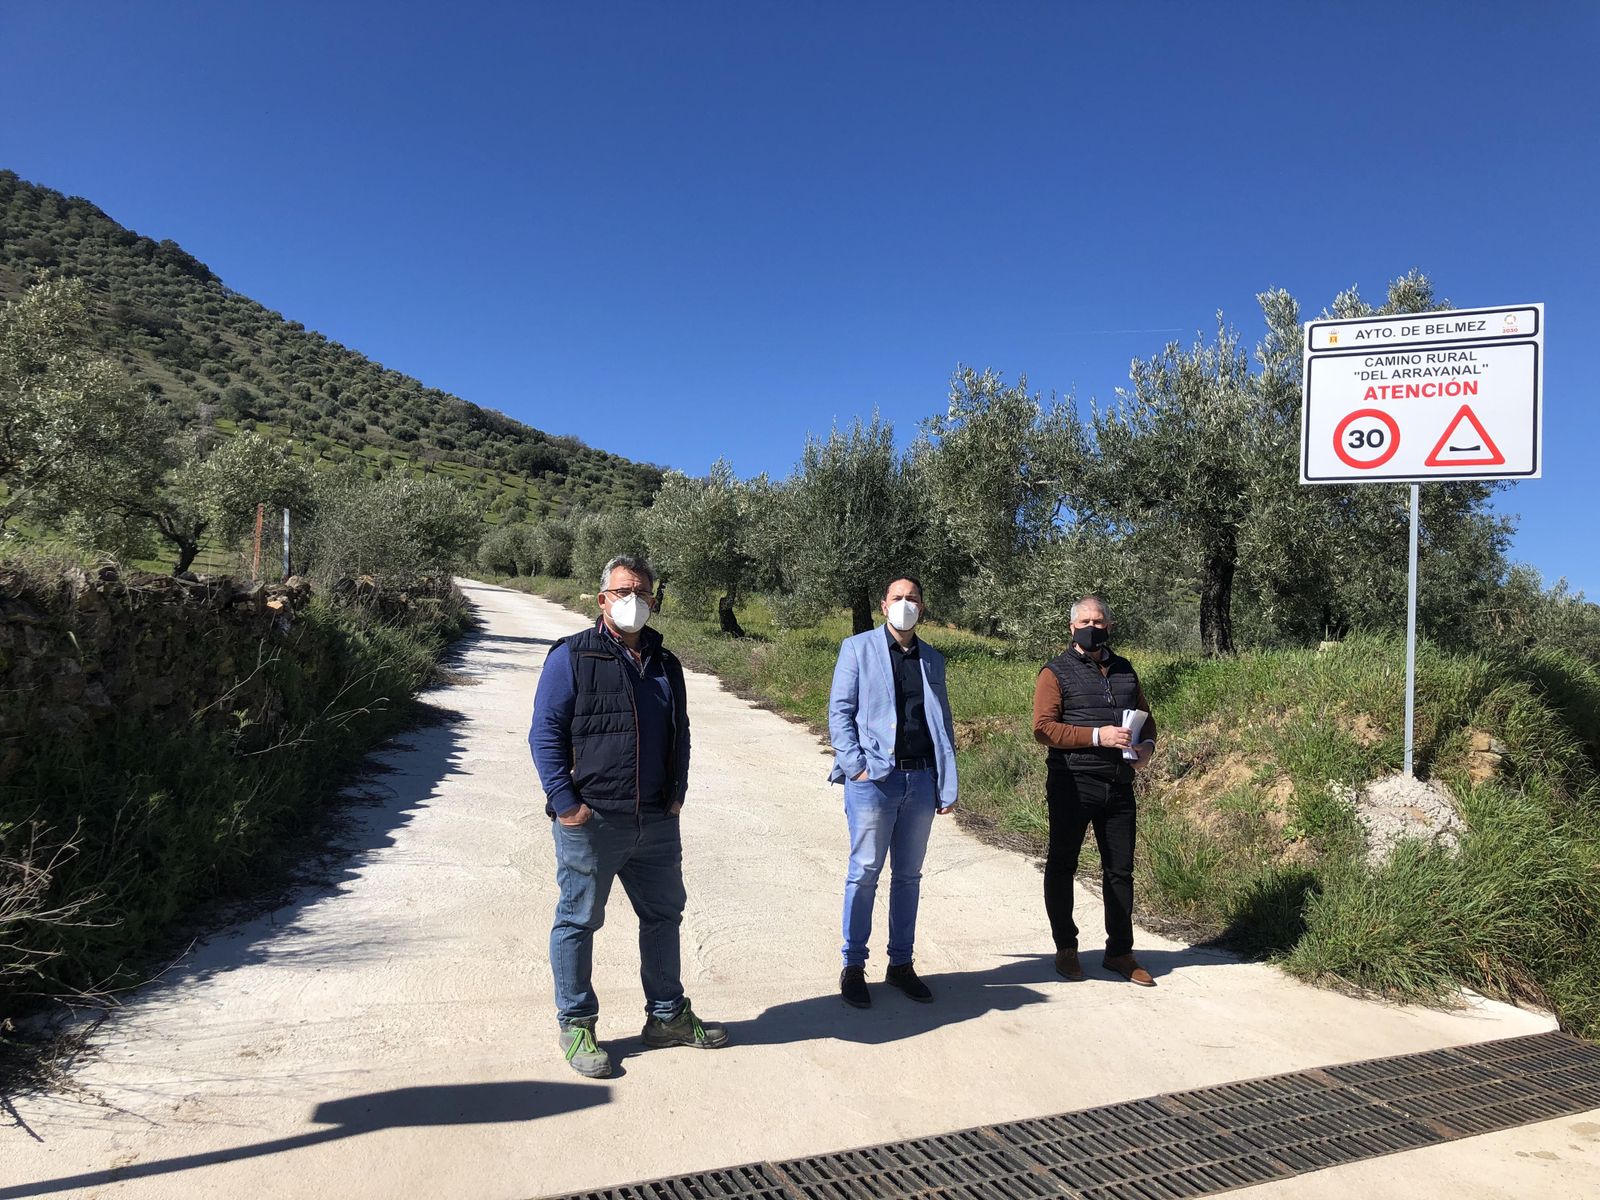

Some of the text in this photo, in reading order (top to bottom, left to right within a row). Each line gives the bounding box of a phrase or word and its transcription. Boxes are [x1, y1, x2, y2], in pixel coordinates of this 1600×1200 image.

[1355, 321, 1486, 340] AYTO. DE BELMEZ
[1365, 351, 1478, 367] CAMINO RURAL
[1354, 364, 1489, 381] "DEL ARRAYANAL"
[1363, 378, 1478, 400] ATENCIÓN
[1348, 429, 1385, 449] 30
